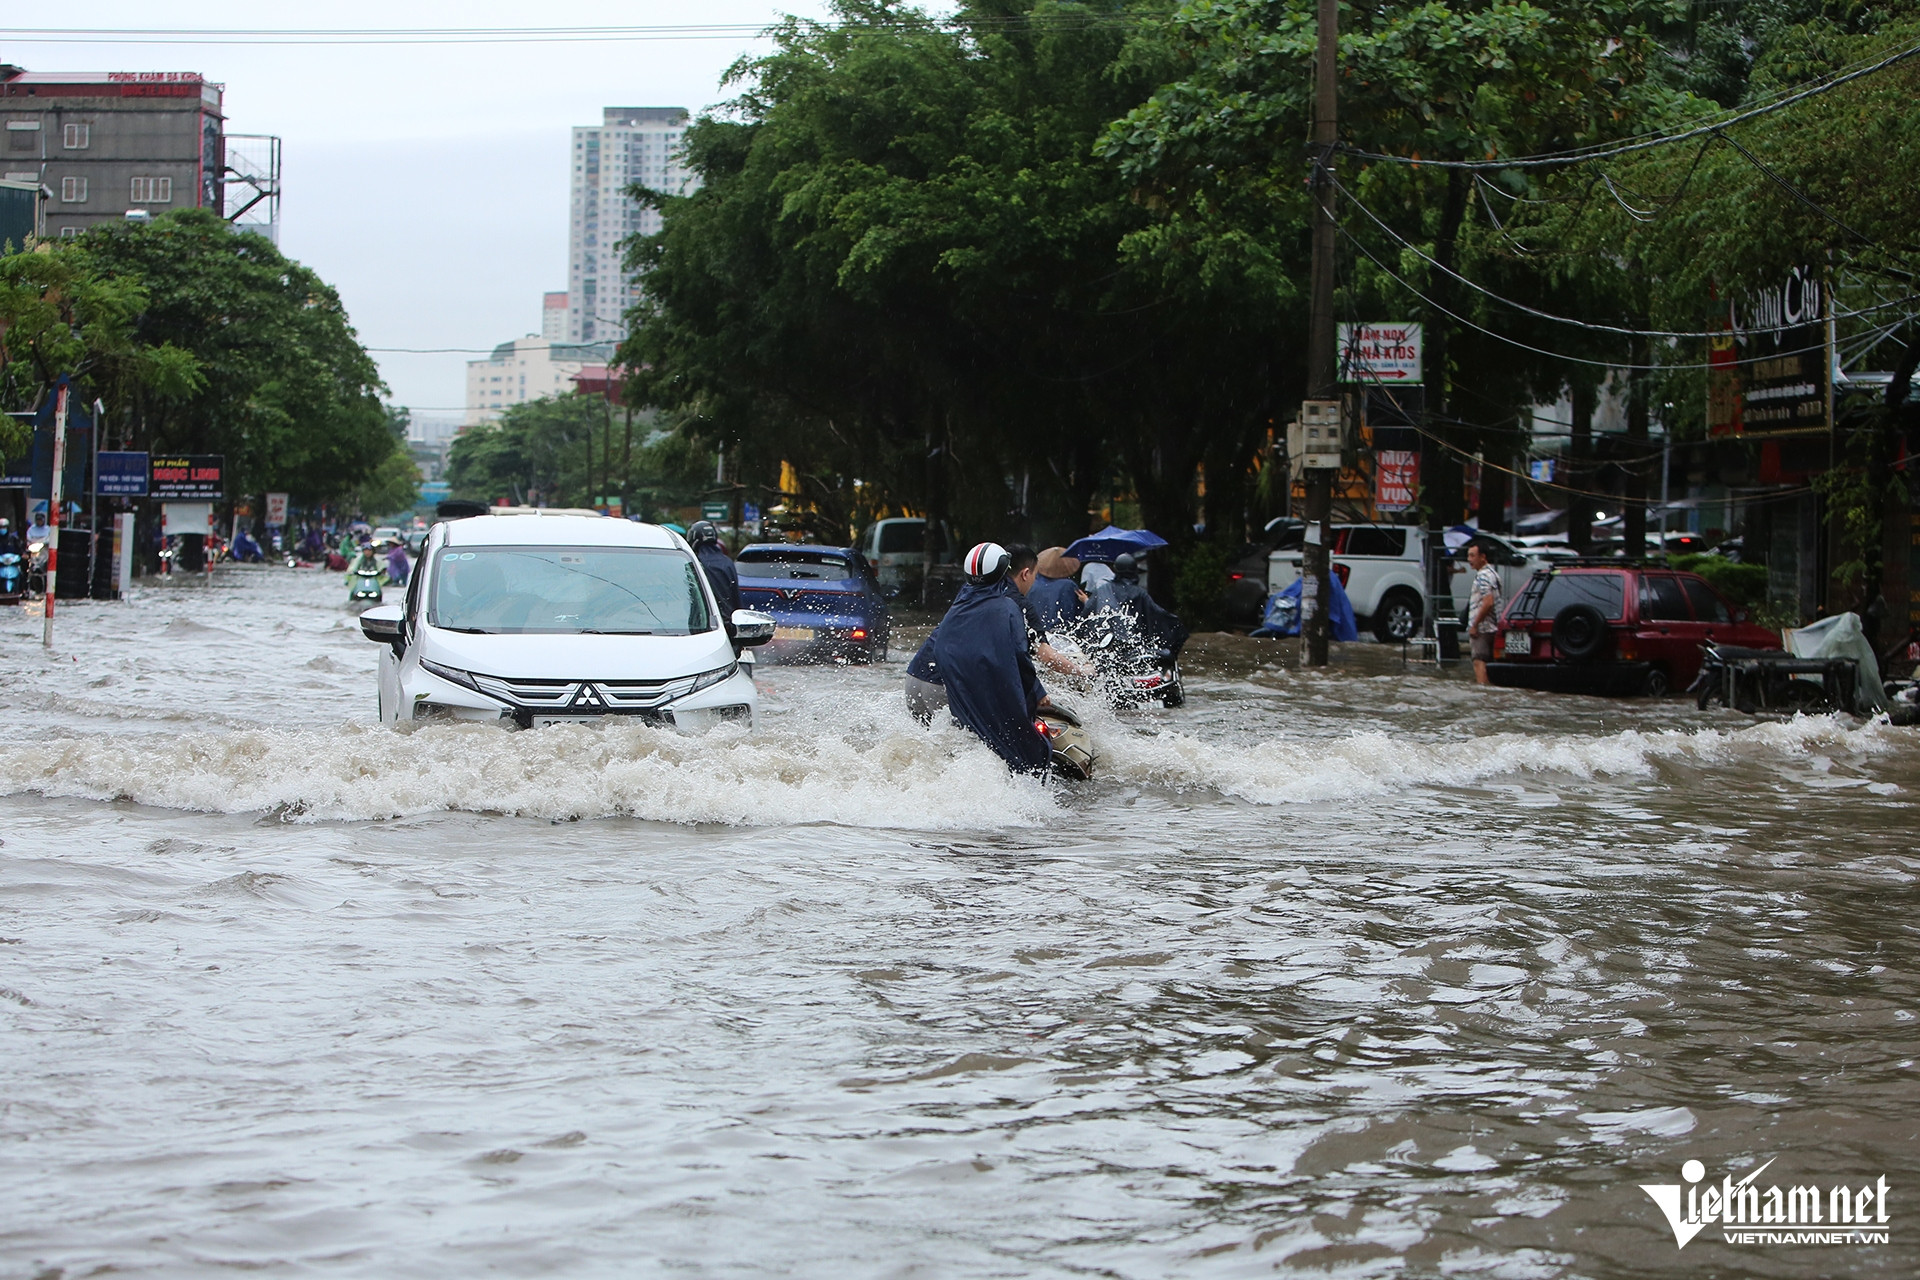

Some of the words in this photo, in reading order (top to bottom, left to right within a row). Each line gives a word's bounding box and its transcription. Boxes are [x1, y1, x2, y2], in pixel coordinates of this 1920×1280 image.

[1381, 450, 1415, 466] MUA
[153, 468, 188, 483] NGỌC
[190, 468, 220, 480] LINH
[1511, 632, 1525, 642] 30A
